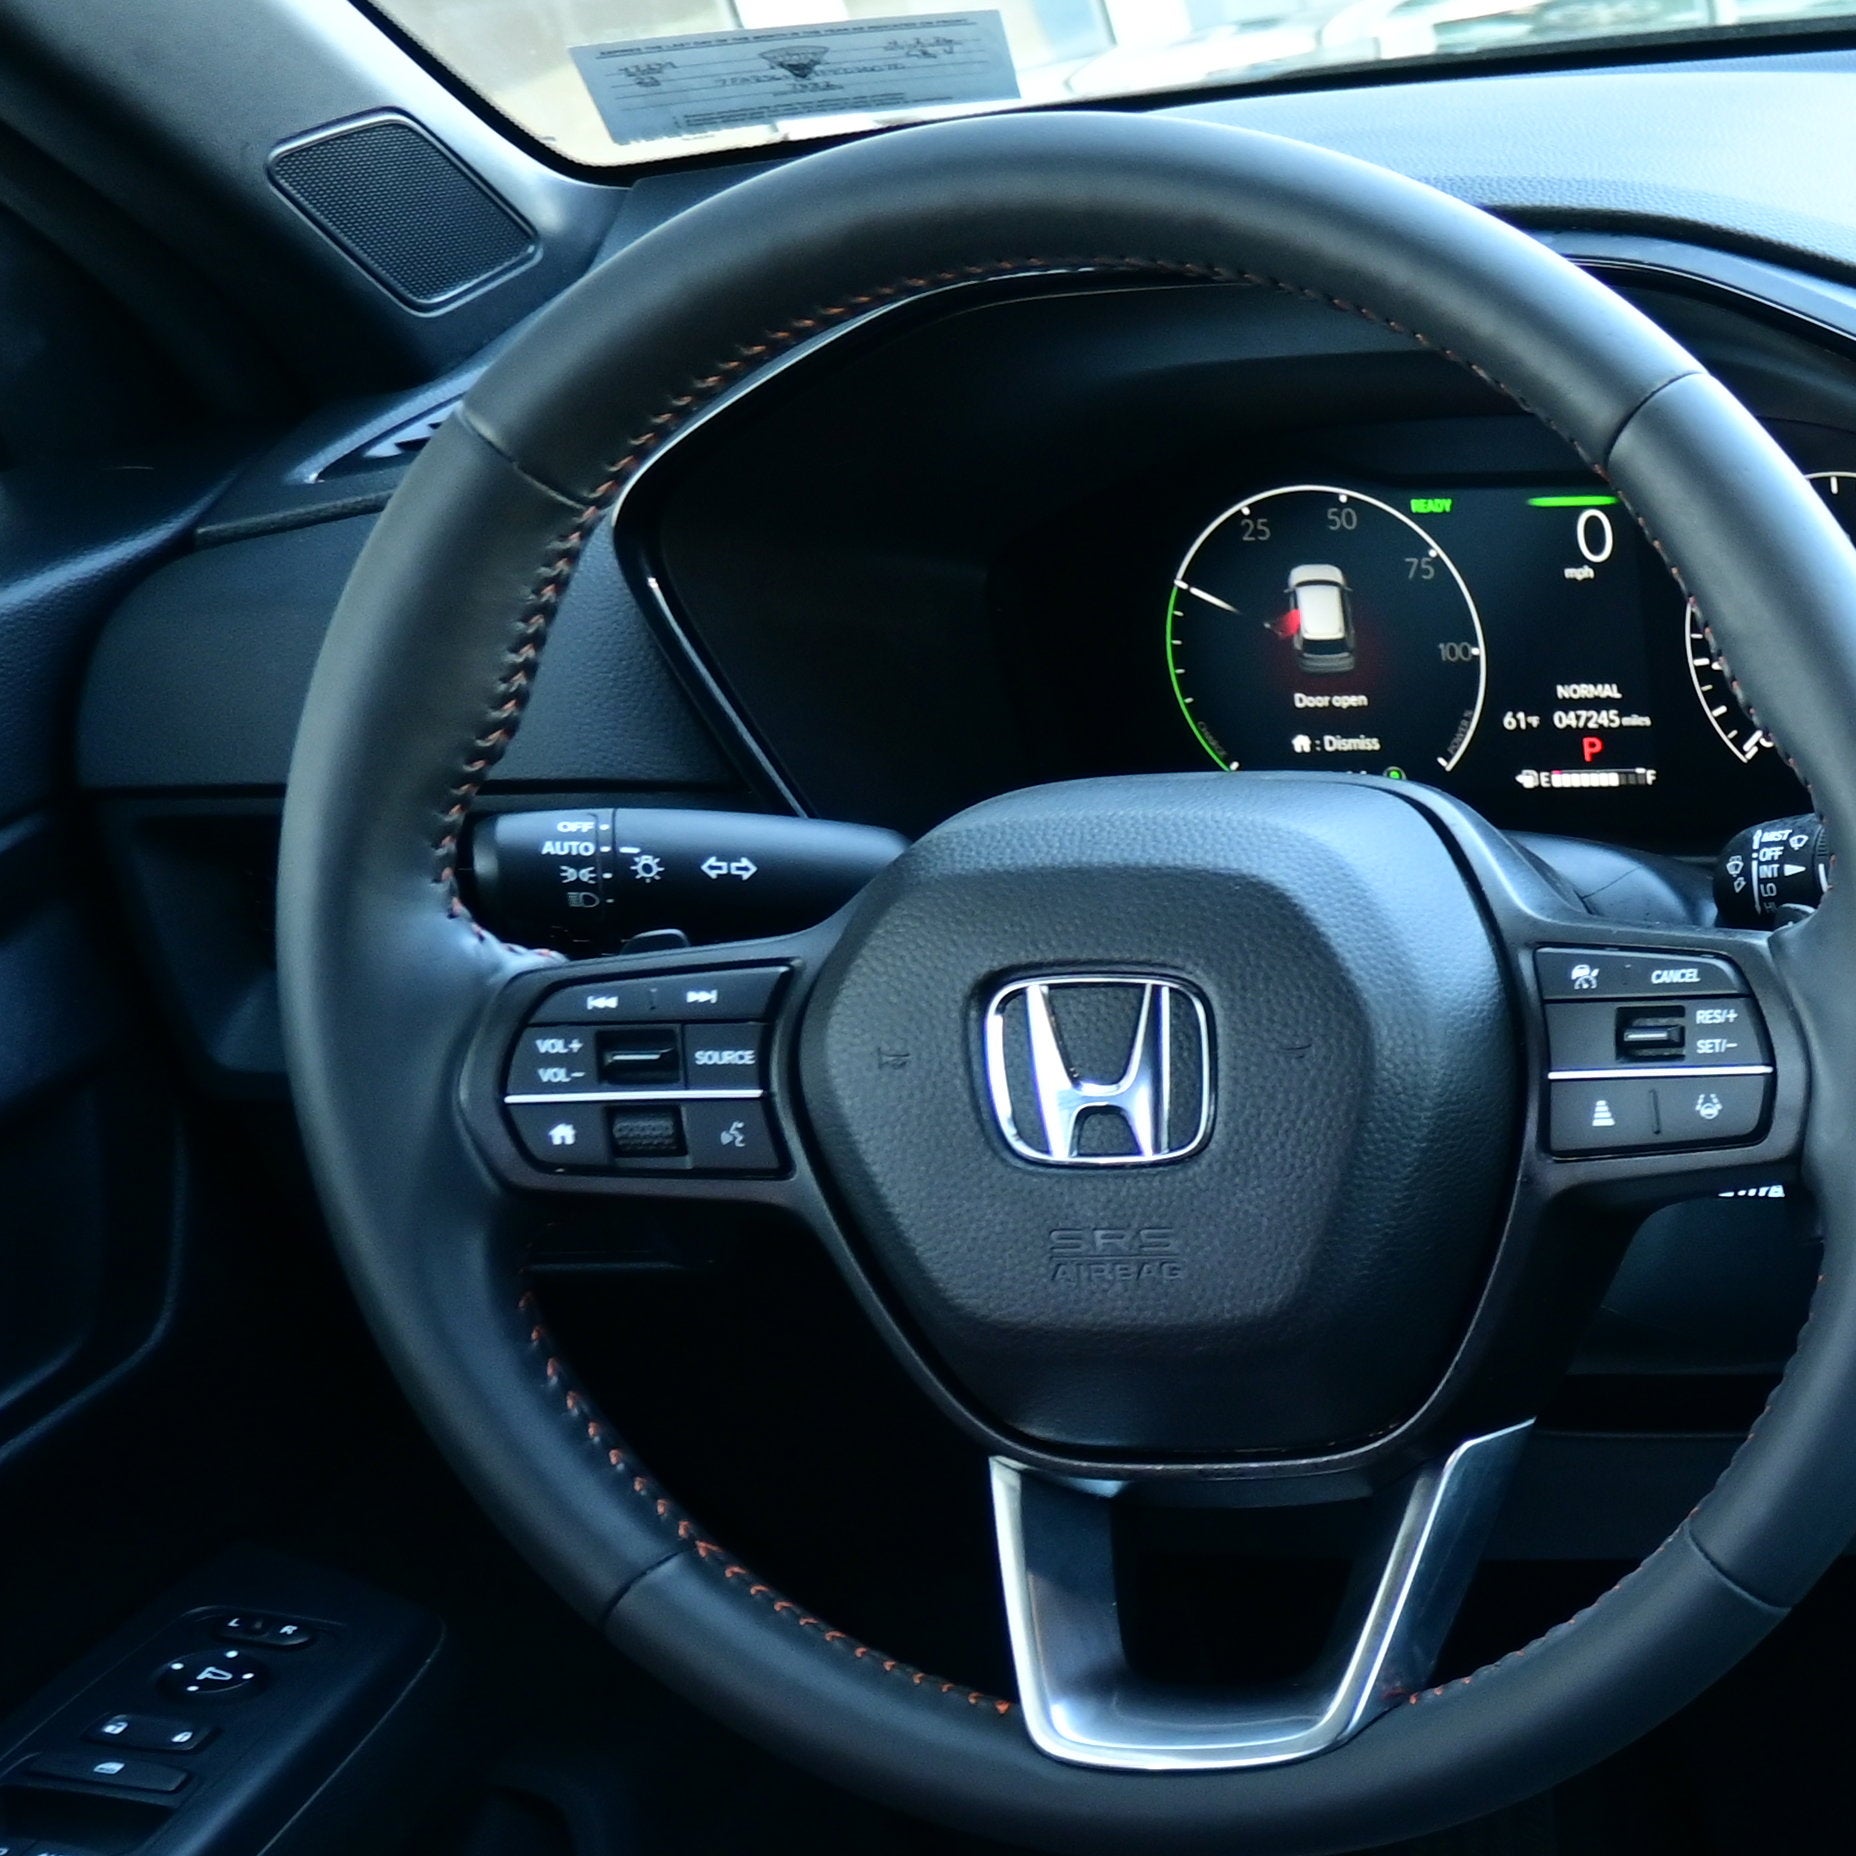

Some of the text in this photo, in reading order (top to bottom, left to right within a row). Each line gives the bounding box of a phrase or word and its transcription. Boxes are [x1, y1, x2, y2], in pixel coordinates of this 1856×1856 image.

[1410, 498, 1452, 513] READY
[1327, 507, 1358, 531] 50
[1241, 518, 1271, 541] 25
[1576, 508, 1614, 563] 0
[1404, 557, 1436, 580] 75
[1563, 566, 1595, 580] mph
[1437, 641, 1471, 662] 100
[1556, 683, 1622, 699] NORMAL
[1293, 692, 1368, 709] Door open
[1553, 709, 1620, 728] 047245
[1323, 735, 1380, 751] Dismiss
[1582, 736, 1603, 762] P
[1539, 771, 1550, 787] E
[1644, 768, 1657, 785] F
[556, 820, 595, 833] OFF
[541, 840, 595, 856] AUTO
[1758, 845, 1786, 863] OFF
[1758, 862, 1782, 879] INT
[1758, 880, 1780, 900] LO
[1650, 968, 1701, 984] CANCEL
[694, 1050, 755, 1065] SOURCE
[1049, 1228, 1175, 1252] SRS
[227, 1618, 239, 1627] L
